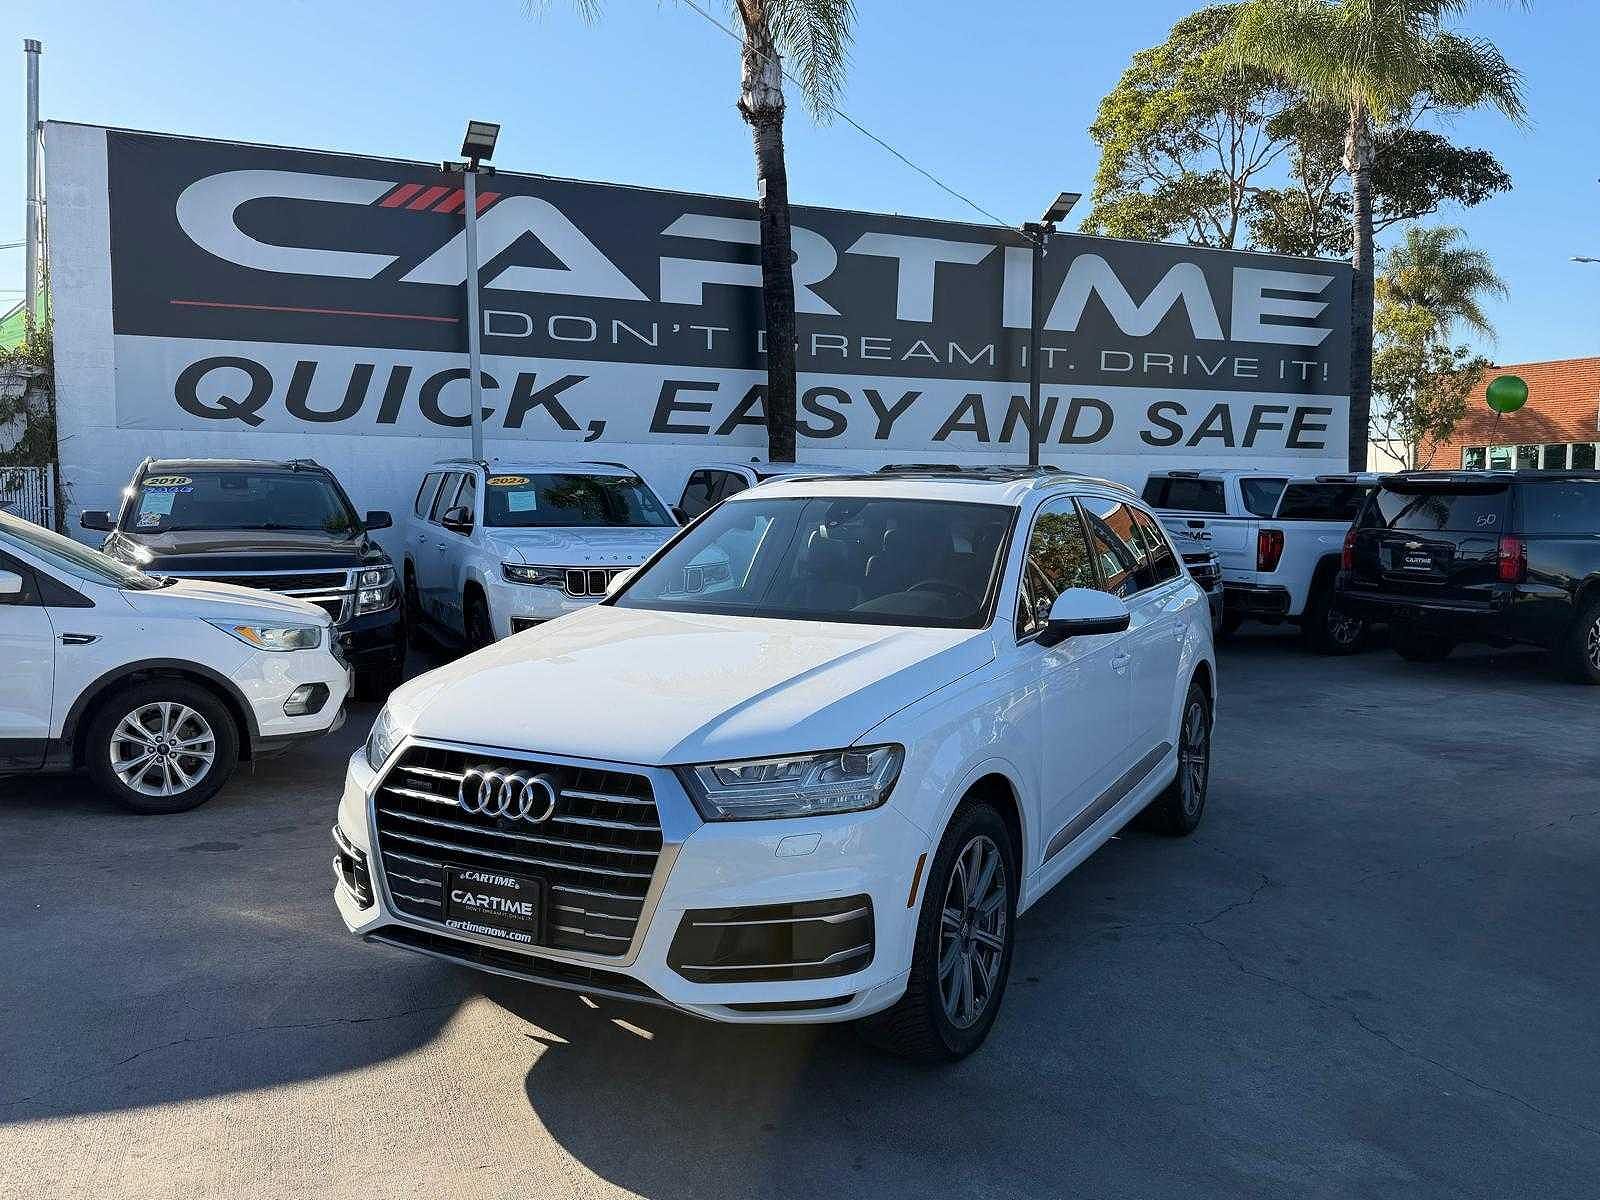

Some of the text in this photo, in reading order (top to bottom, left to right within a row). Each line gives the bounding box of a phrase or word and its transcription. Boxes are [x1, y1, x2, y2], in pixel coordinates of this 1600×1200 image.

[175, 169, 1334, 347] CARTIME
[484, 309, 729, 348] DON'T
[1021, 346, 1076, 370] IT.
[1100, 350, 1258, 379] DRIVE
[1278, 359, 1330, 382] IT!
[174, 356, 1334, 449] QUICK, EASY AND SAFE
[148, 477, 187, 485] 2018
[465, 871, 516, 888] CARTIME
[451, 889, 533, 916] CARTIME
[445, 919, 532, 943] cartimenow.com
